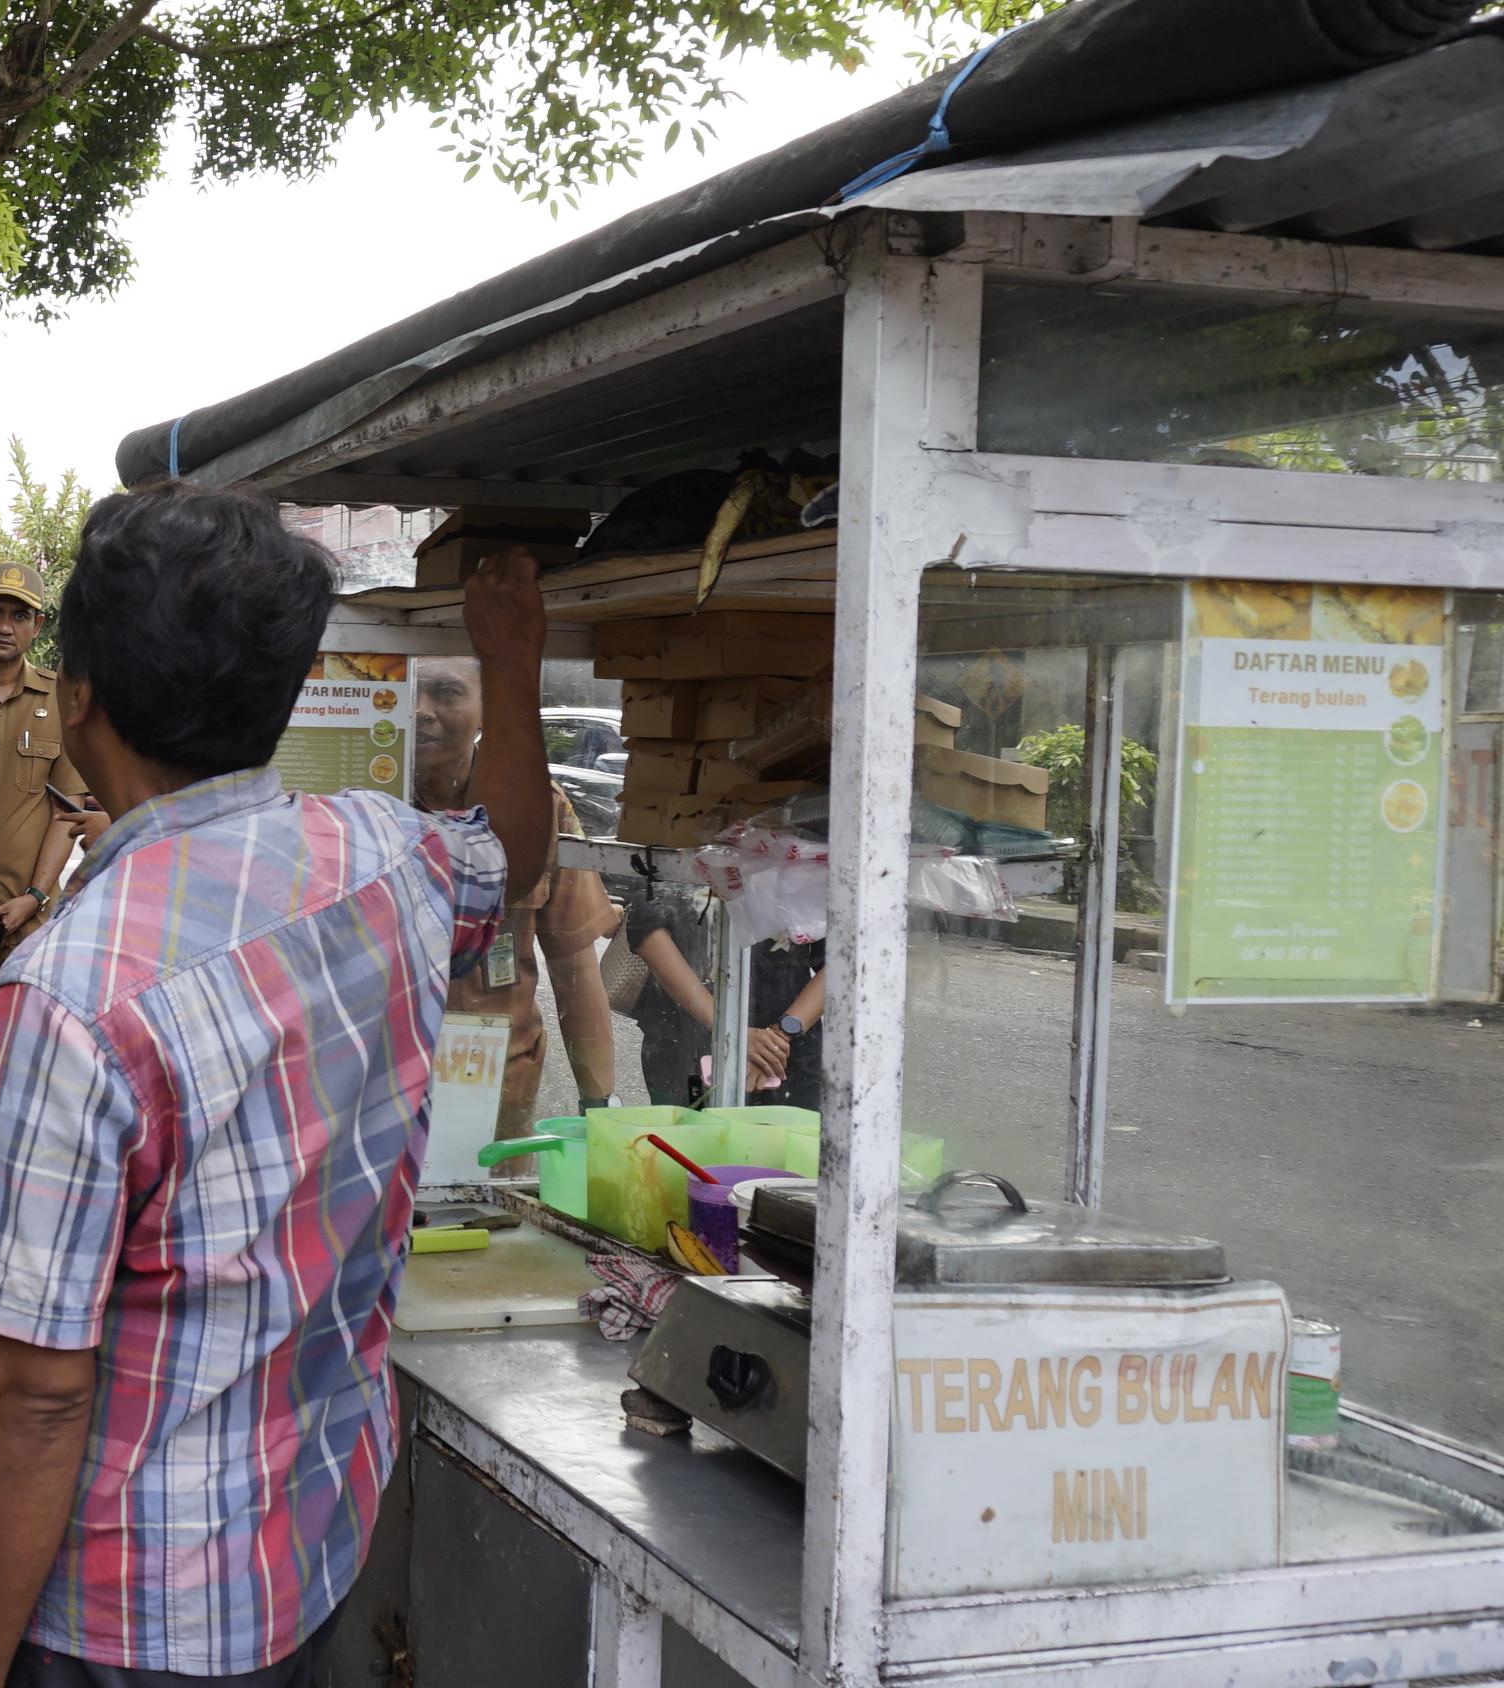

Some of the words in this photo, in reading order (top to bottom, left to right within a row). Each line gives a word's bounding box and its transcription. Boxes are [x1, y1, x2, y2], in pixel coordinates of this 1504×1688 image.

[1234, 652, 1317, 673] DAFTAR
[1322, 655, 1386, 675] MENU
[301, 686, 329, 697] TAR
[332, 687, 371, 698] MENU
[1249, 687, 1311, 709] Terang
[1315, 690, 1367, 706] bulan
[292, 706, 326, 716] erang
[328, 706, 360, 715] bulan
[898, 1354, 1103, 1434] TERANG
[1116, 1351, 1277, 1426] BULAN
[1051, 1466, 1148, 1544] MINI
